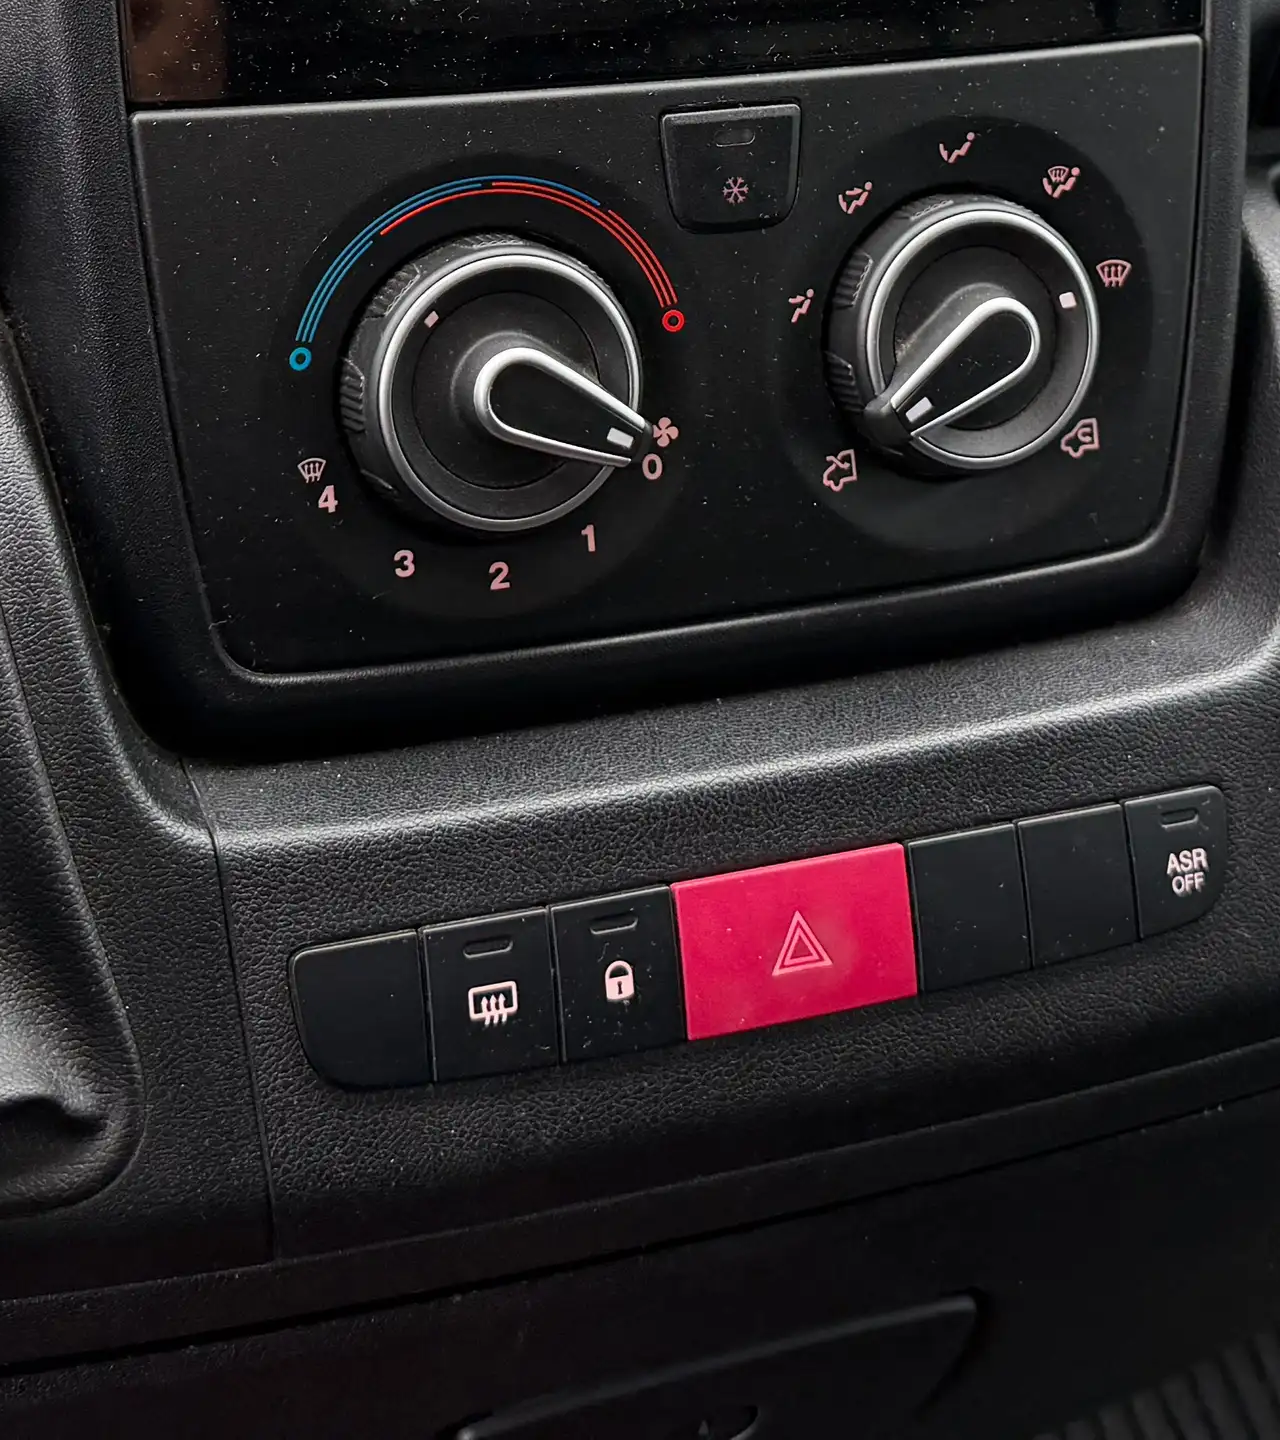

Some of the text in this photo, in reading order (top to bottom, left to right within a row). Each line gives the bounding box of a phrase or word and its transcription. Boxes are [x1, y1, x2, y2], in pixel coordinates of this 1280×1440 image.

[641, 454, 663, 480] 0
[318, 485, 338, 513] 4
[581, 524, 597, 552] 1
[394, 549, 416, 578] 3
[489, 562, 511, 591] 2
[1166, 847, 1209, 875] ASR
[1171, 871, 1205, 897] OFF
